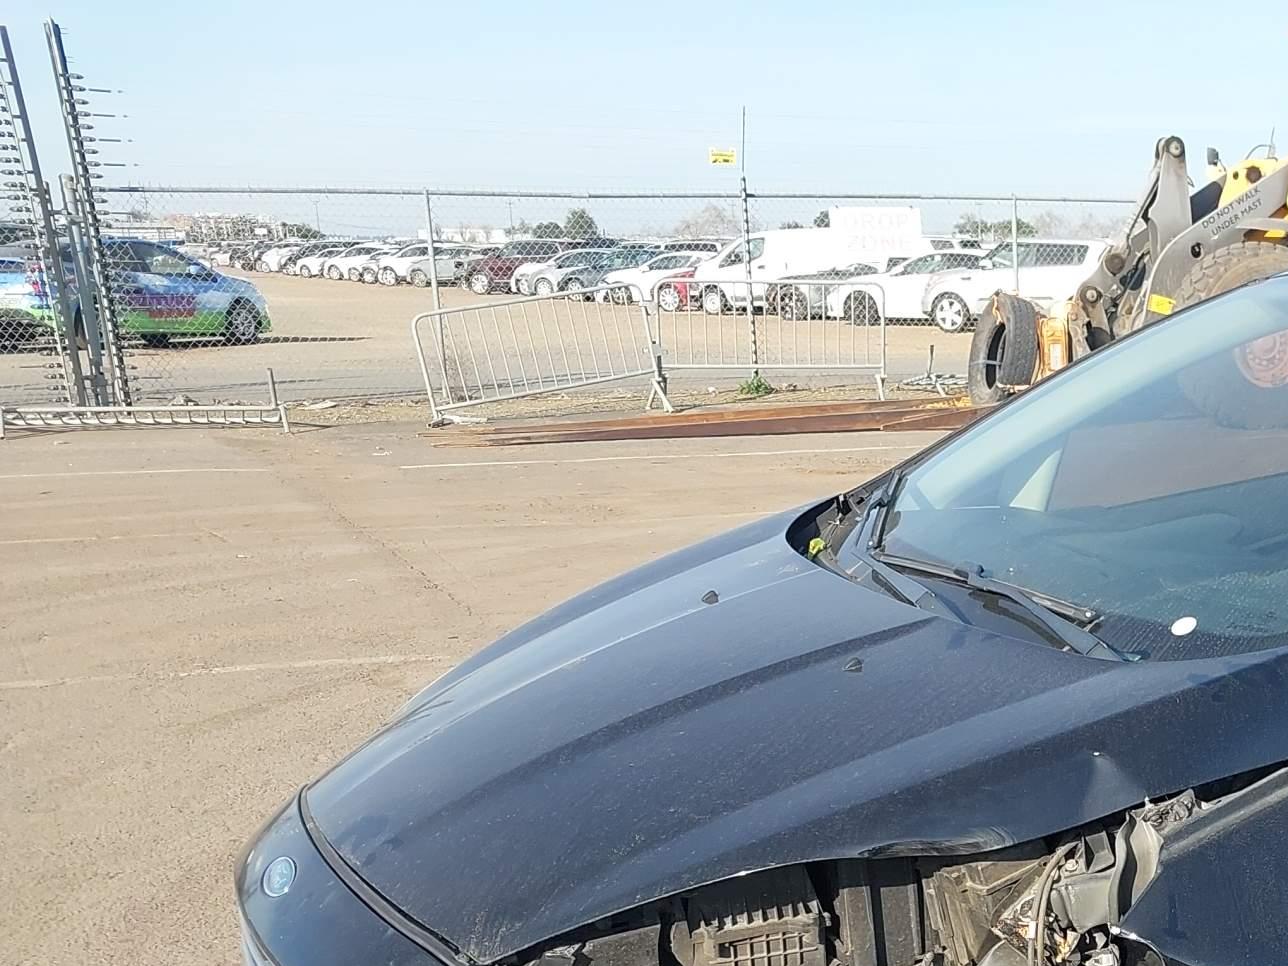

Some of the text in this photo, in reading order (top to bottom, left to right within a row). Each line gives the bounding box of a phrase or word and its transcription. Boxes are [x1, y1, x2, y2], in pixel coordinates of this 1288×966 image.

[1201, 185, 1261, 229] DO NOT WALK
[1211, 198, 1262, 236] UNDER MAST
